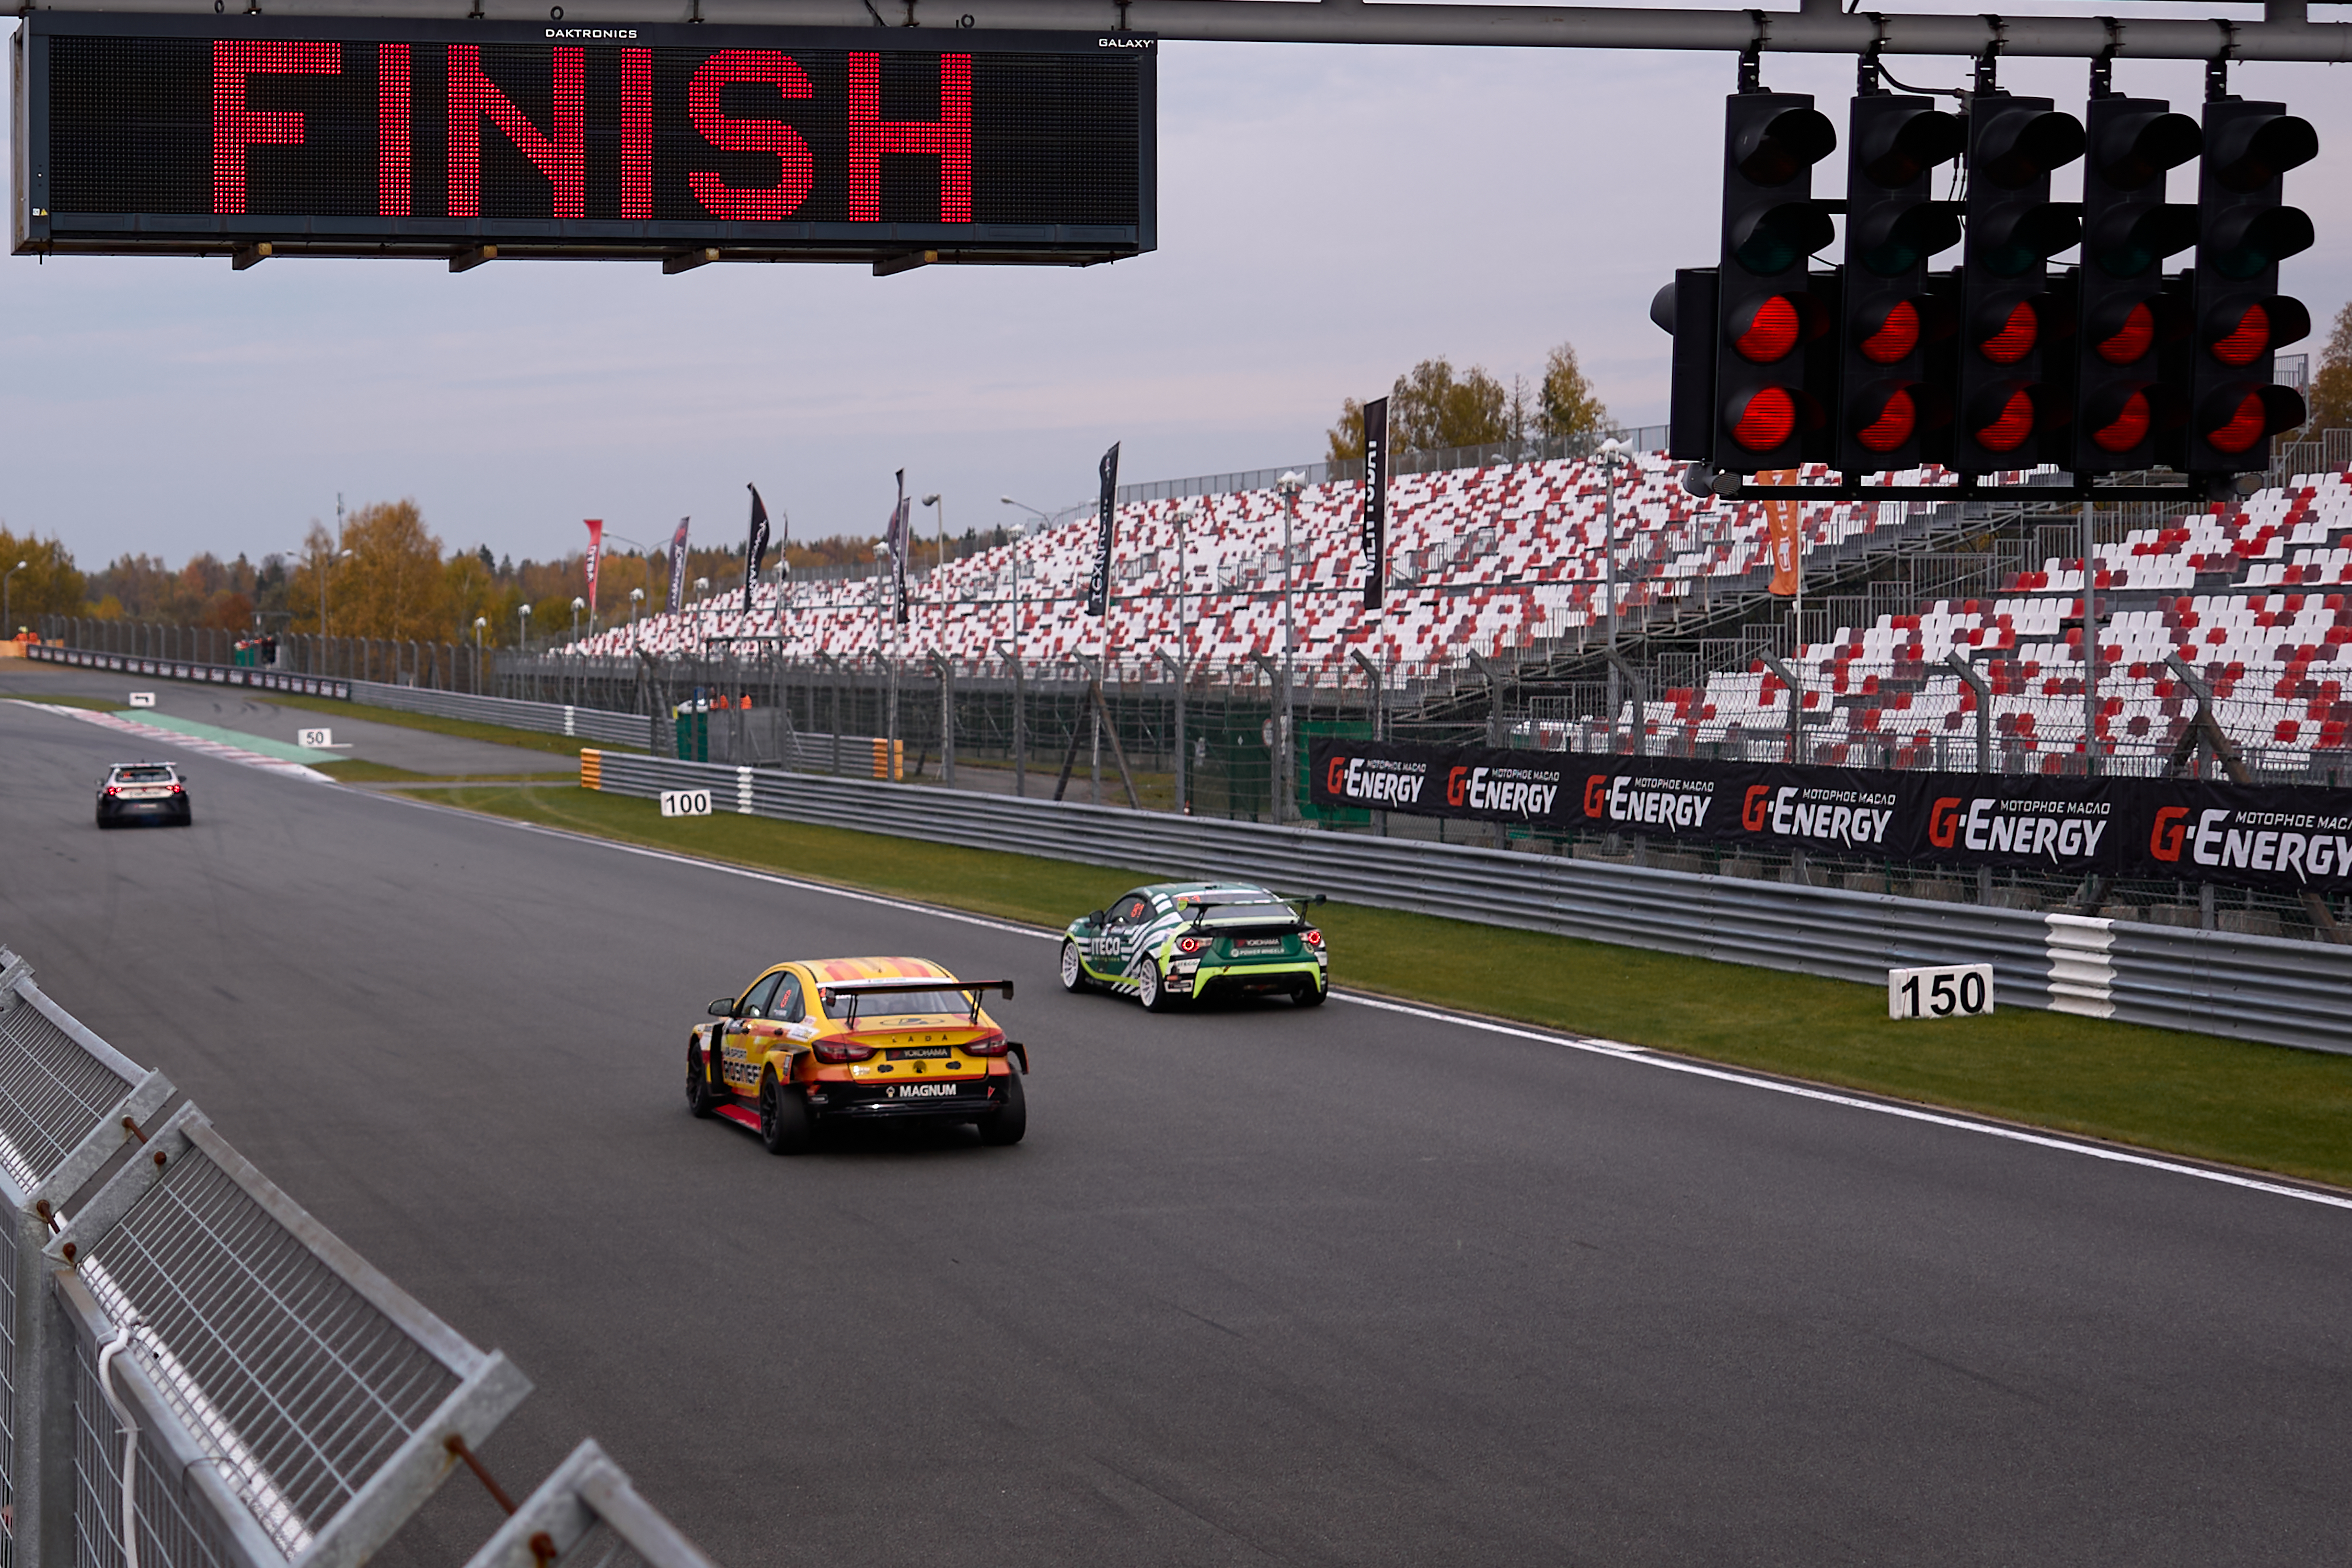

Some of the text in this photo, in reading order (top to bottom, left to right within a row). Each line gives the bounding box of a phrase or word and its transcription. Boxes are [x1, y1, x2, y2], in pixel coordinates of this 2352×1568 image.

[545, 29, 637, 38] DAKTRONICS
[1099, 39, 1151, 48] GALAXY
[213, 39, 973, 223] FINISH
[307, 732, 324, 744] 50
[1328, 757, 1424, 808] G-ENERGY
[1634, 777, 1714, 792] МОТОРНОЕ МАСЛО
[1447, 766, 1558, 820] G-ENERGY
[1803, 788, 1896, 805] МОТОРНОЕ МАСЛО
[666, 793, 706, 813] 100
[1584, 775, 1712, 833] G-ENERGY
[2001, 800, 2111, 814] МОТОРНОЕ МАСЛО
[1742, 785, 1893, 849] G-ENERGY
[2235, 811, 2315, 828] МОТОРНОЕ
[1929, 797, 2107, 864] G-ENERGY
[1091, 937, 1120, 955] ITECO
[1901, 972, 1985, 1016] 150
[892, 1034, 948, 1043] LADA
[904, 1048, 947, 1057] YOKOHAMA
[900, 1083, 956, 1097] MAGNUM
